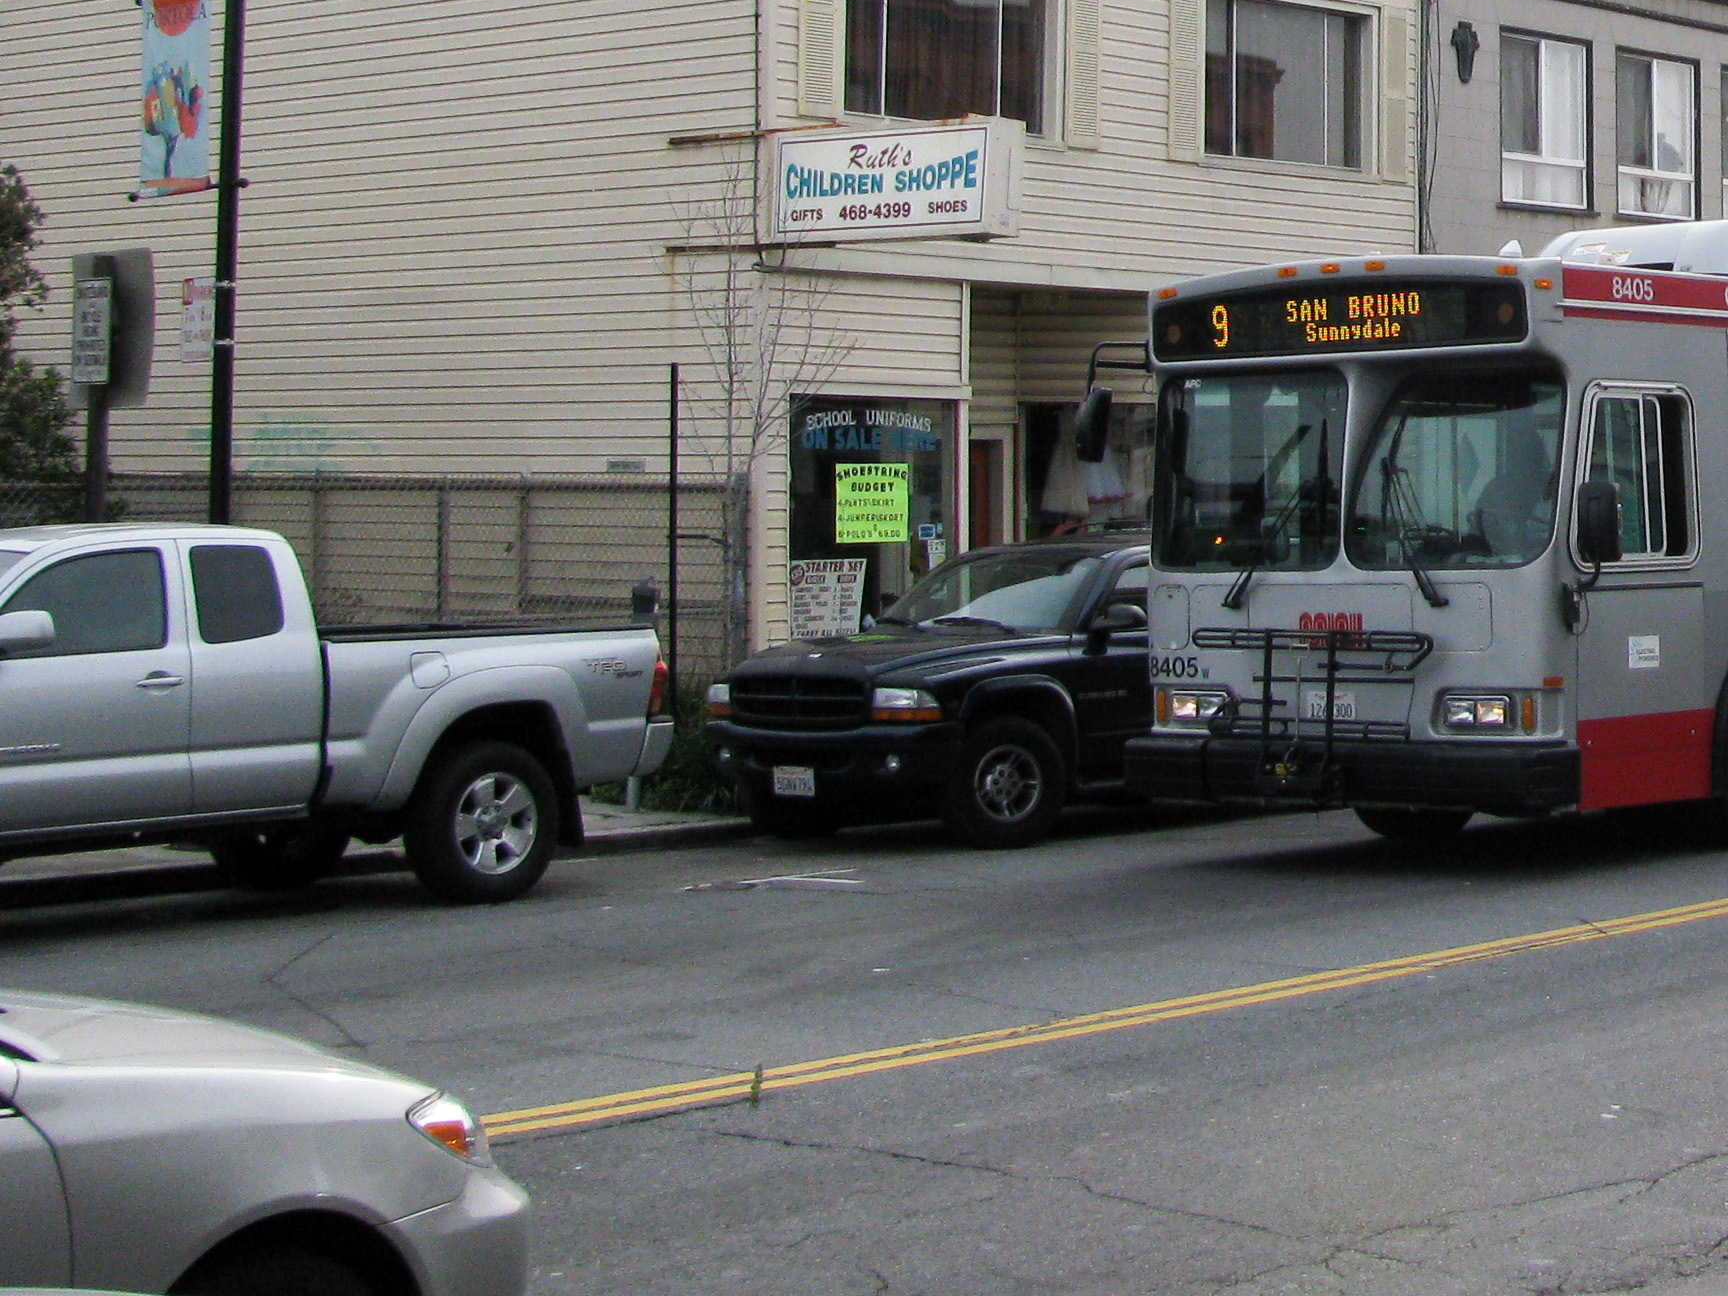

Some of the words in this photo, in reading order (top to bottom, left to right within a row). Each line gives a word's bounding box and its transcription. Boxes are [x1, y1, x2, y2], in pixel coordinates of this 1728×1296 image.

[846, 141, 913, 170] Ruth's
[786, 162, 884, 199] CHILDREN
[894, 149, 979, 193] SHOPPE
[790, 207, 823, 222] GIFTS
[838, 200, 912, 221] 468-4399
[927, 198, 969, 215] SHOES
[1612, 276, 1655, 302] 8405
[1285, 298, 1329, 324] SAN
[1347, 291, 1422, 319] BRUNO
[1211, 304, 1231, 347] 9
[1304, 316, 1402, 343] Sunnydale
[805, 410, 857, 431] SCHOOL
[865, 410, 932, 432] UNIFORMS
[802, 427, 829, 450] ON
[834, 427, 882, 450] SALE
[837, 465, 909, 482] SHOESTRING
[851, 482, 895, 493] BUDGET
[805, 561, 846, 573] STARTER
[847, 560, 865, 572] SET
[1151, 656, 1199, 679] 8405
